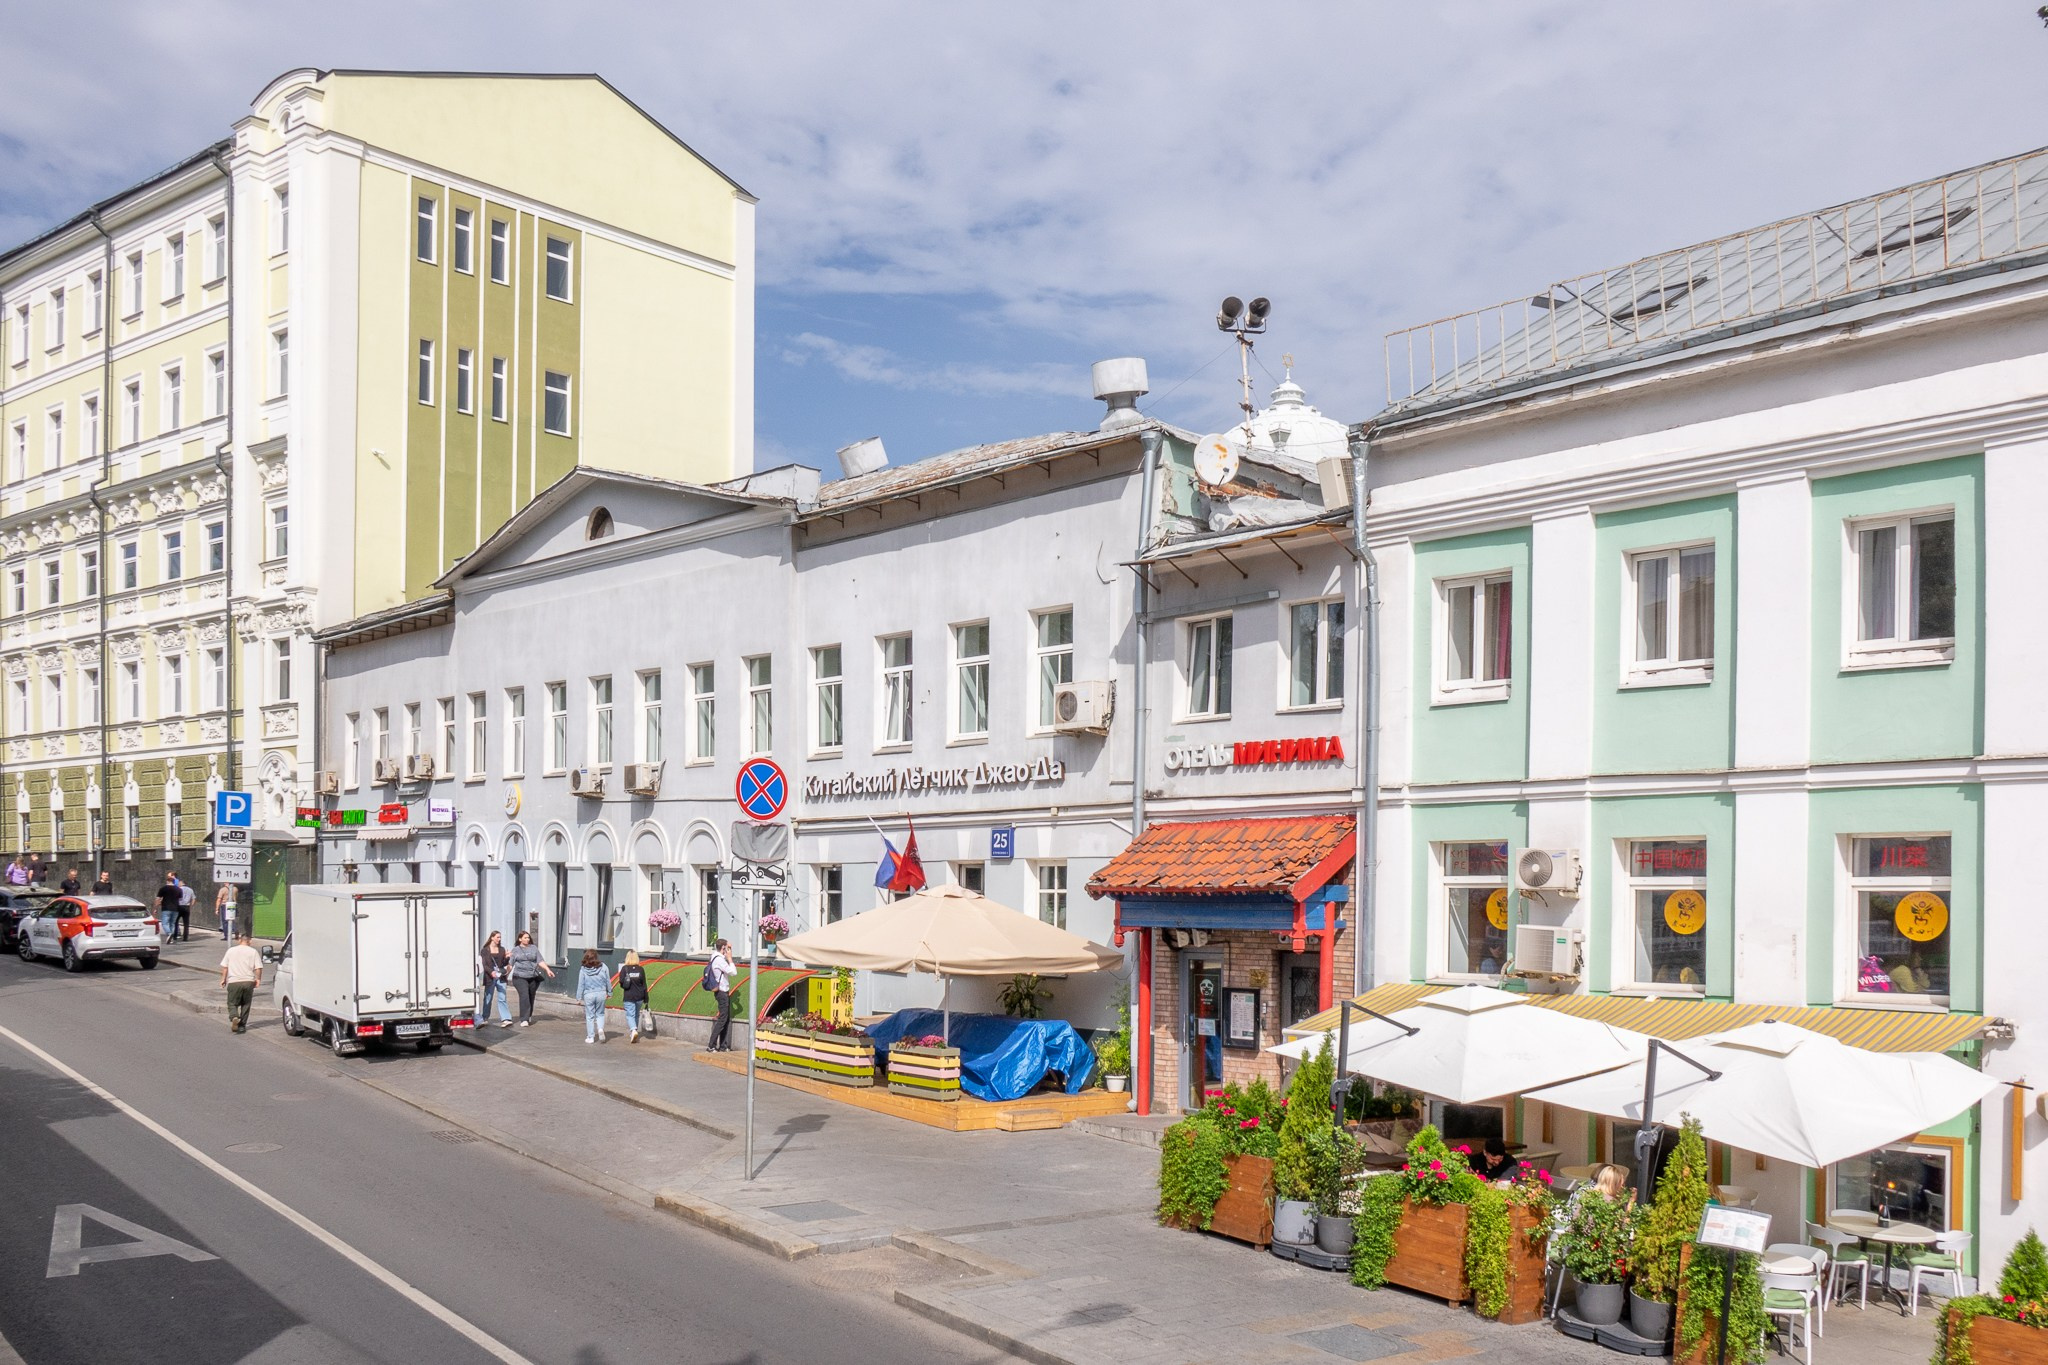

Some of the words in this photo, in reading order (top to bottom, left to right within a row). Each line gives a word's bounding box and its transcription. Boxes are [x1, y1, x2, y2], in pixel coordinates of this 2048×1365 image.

[1165, 743, 1232, 769] ОТЕЛЬ
[1233, 735, 1344, 765] МИНИМА
[803, 769, 896, 797] Китайский
[900, 767, 967, 790] Лётчик
[973, 762, 1030, 785] Джао
[1032, 756, 1065, 780] Да
[225, 795, 246, 823] P
[993, 832, 1008, 848] 25
[236, 852, 247, 860] 20
[1880, 845, 1928, 868] 川菜
